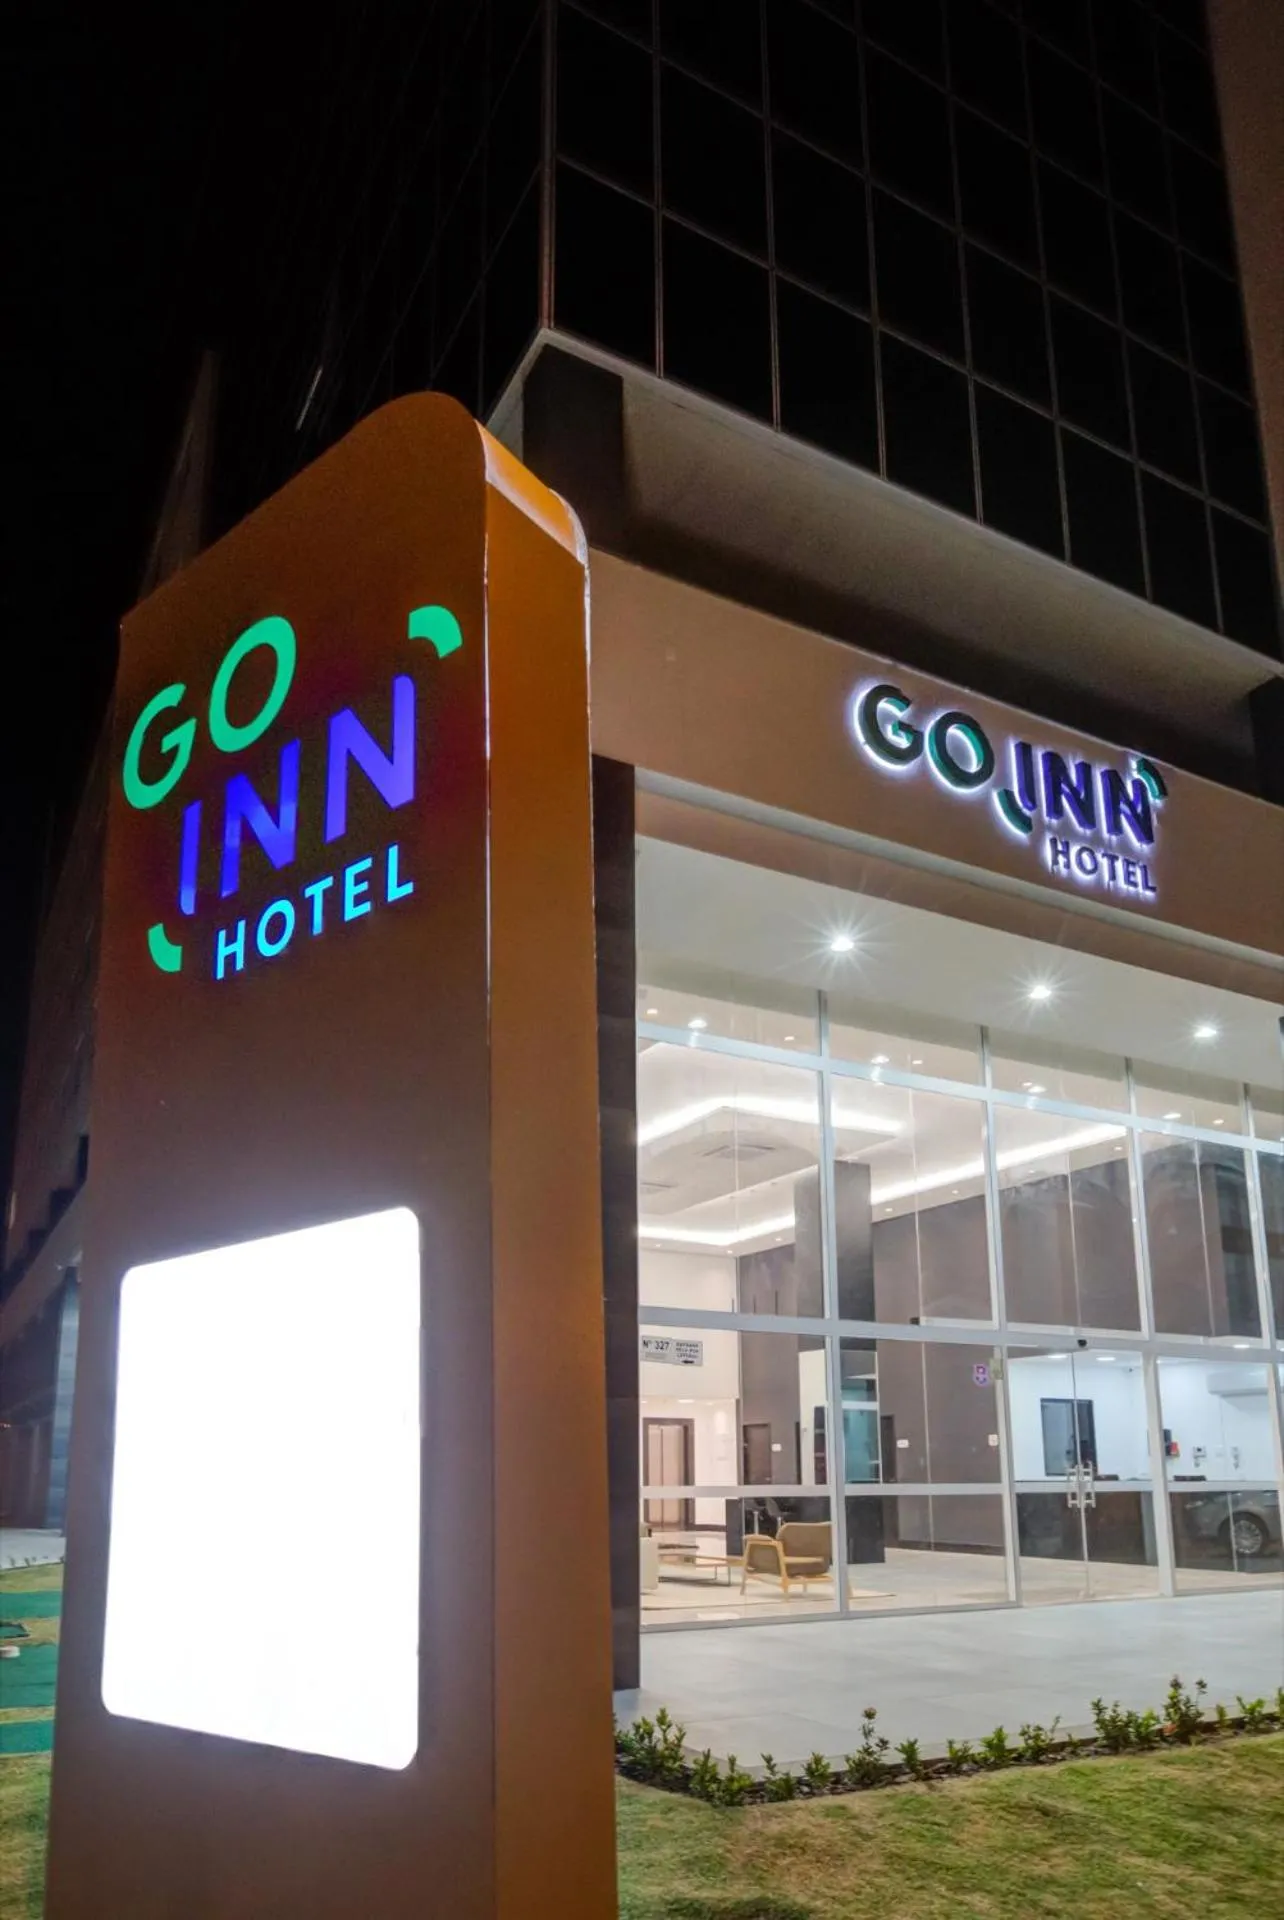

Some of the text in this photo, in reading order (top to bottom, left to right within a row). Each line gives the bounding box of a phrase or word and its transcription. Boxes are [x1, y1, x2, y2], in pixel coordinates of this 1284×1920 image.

[123, 615, 297, 810] GO
[856, 684, 1156, 846] GO INN
[178, 673, 417, 916] INN
[1048, 836, 1158, 895] HOTEL
[214, 844, 415, 980] HOTEL
[655, 1340, 670, 1350] 327
